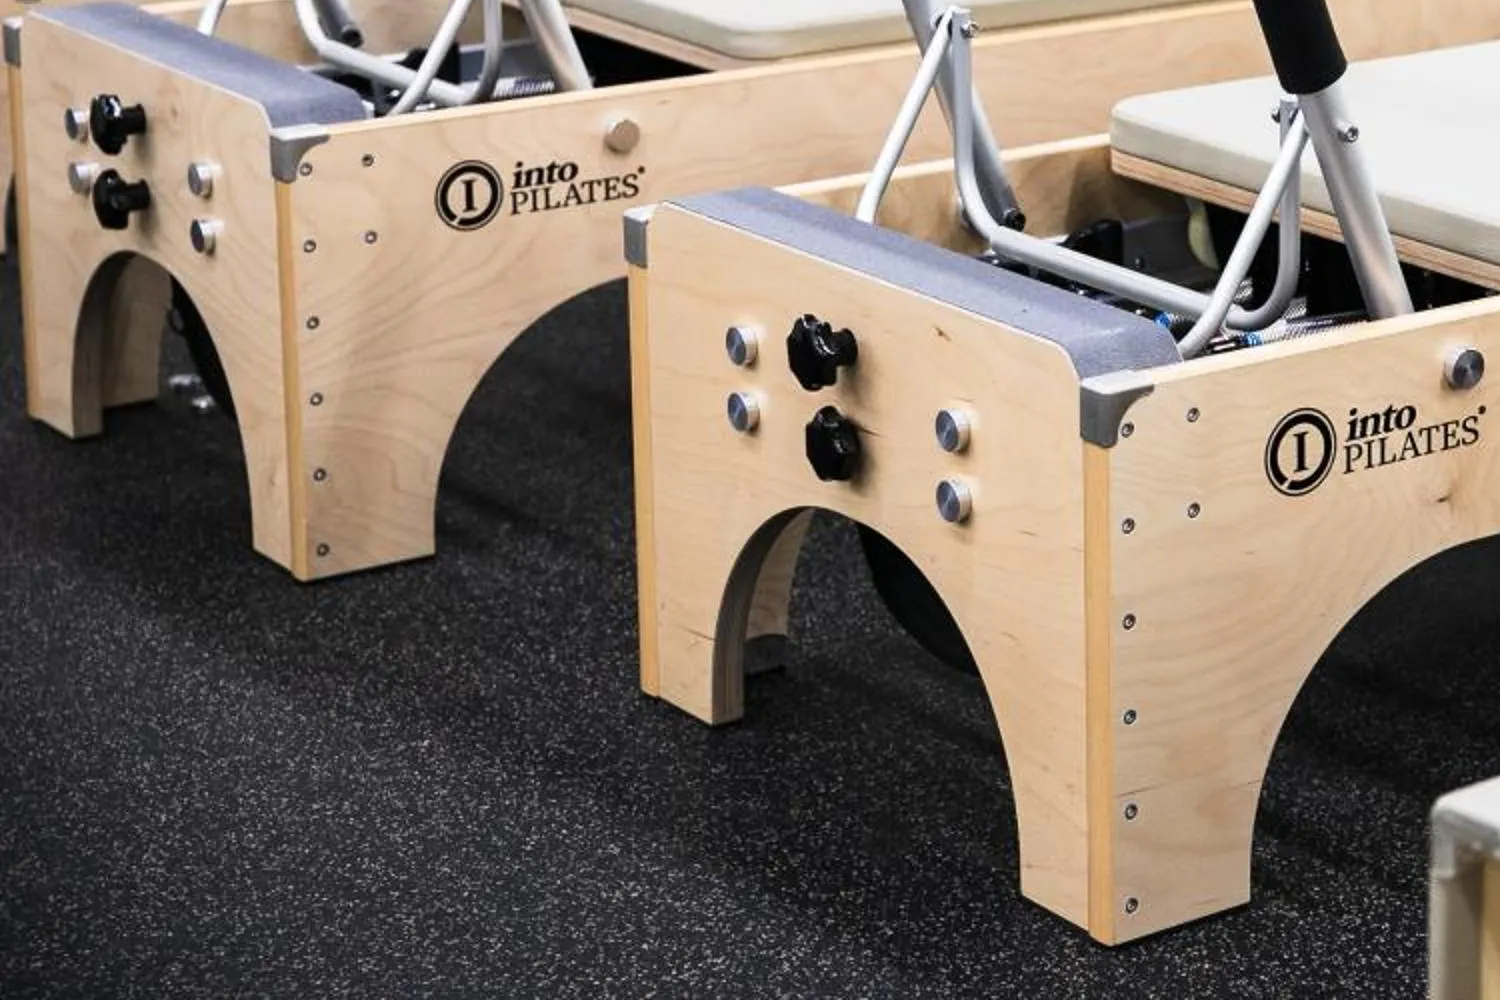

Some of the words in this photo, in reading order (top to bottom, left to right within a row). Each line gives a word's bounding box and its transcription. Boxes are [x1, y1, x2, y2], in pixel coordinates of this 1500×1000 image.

[510, 173, 640, 216] PILATES
[512, 161, 579, 190] into
[1345, 404, 1417, 443] into
[1342, 415, 1480, 475] PILATES
